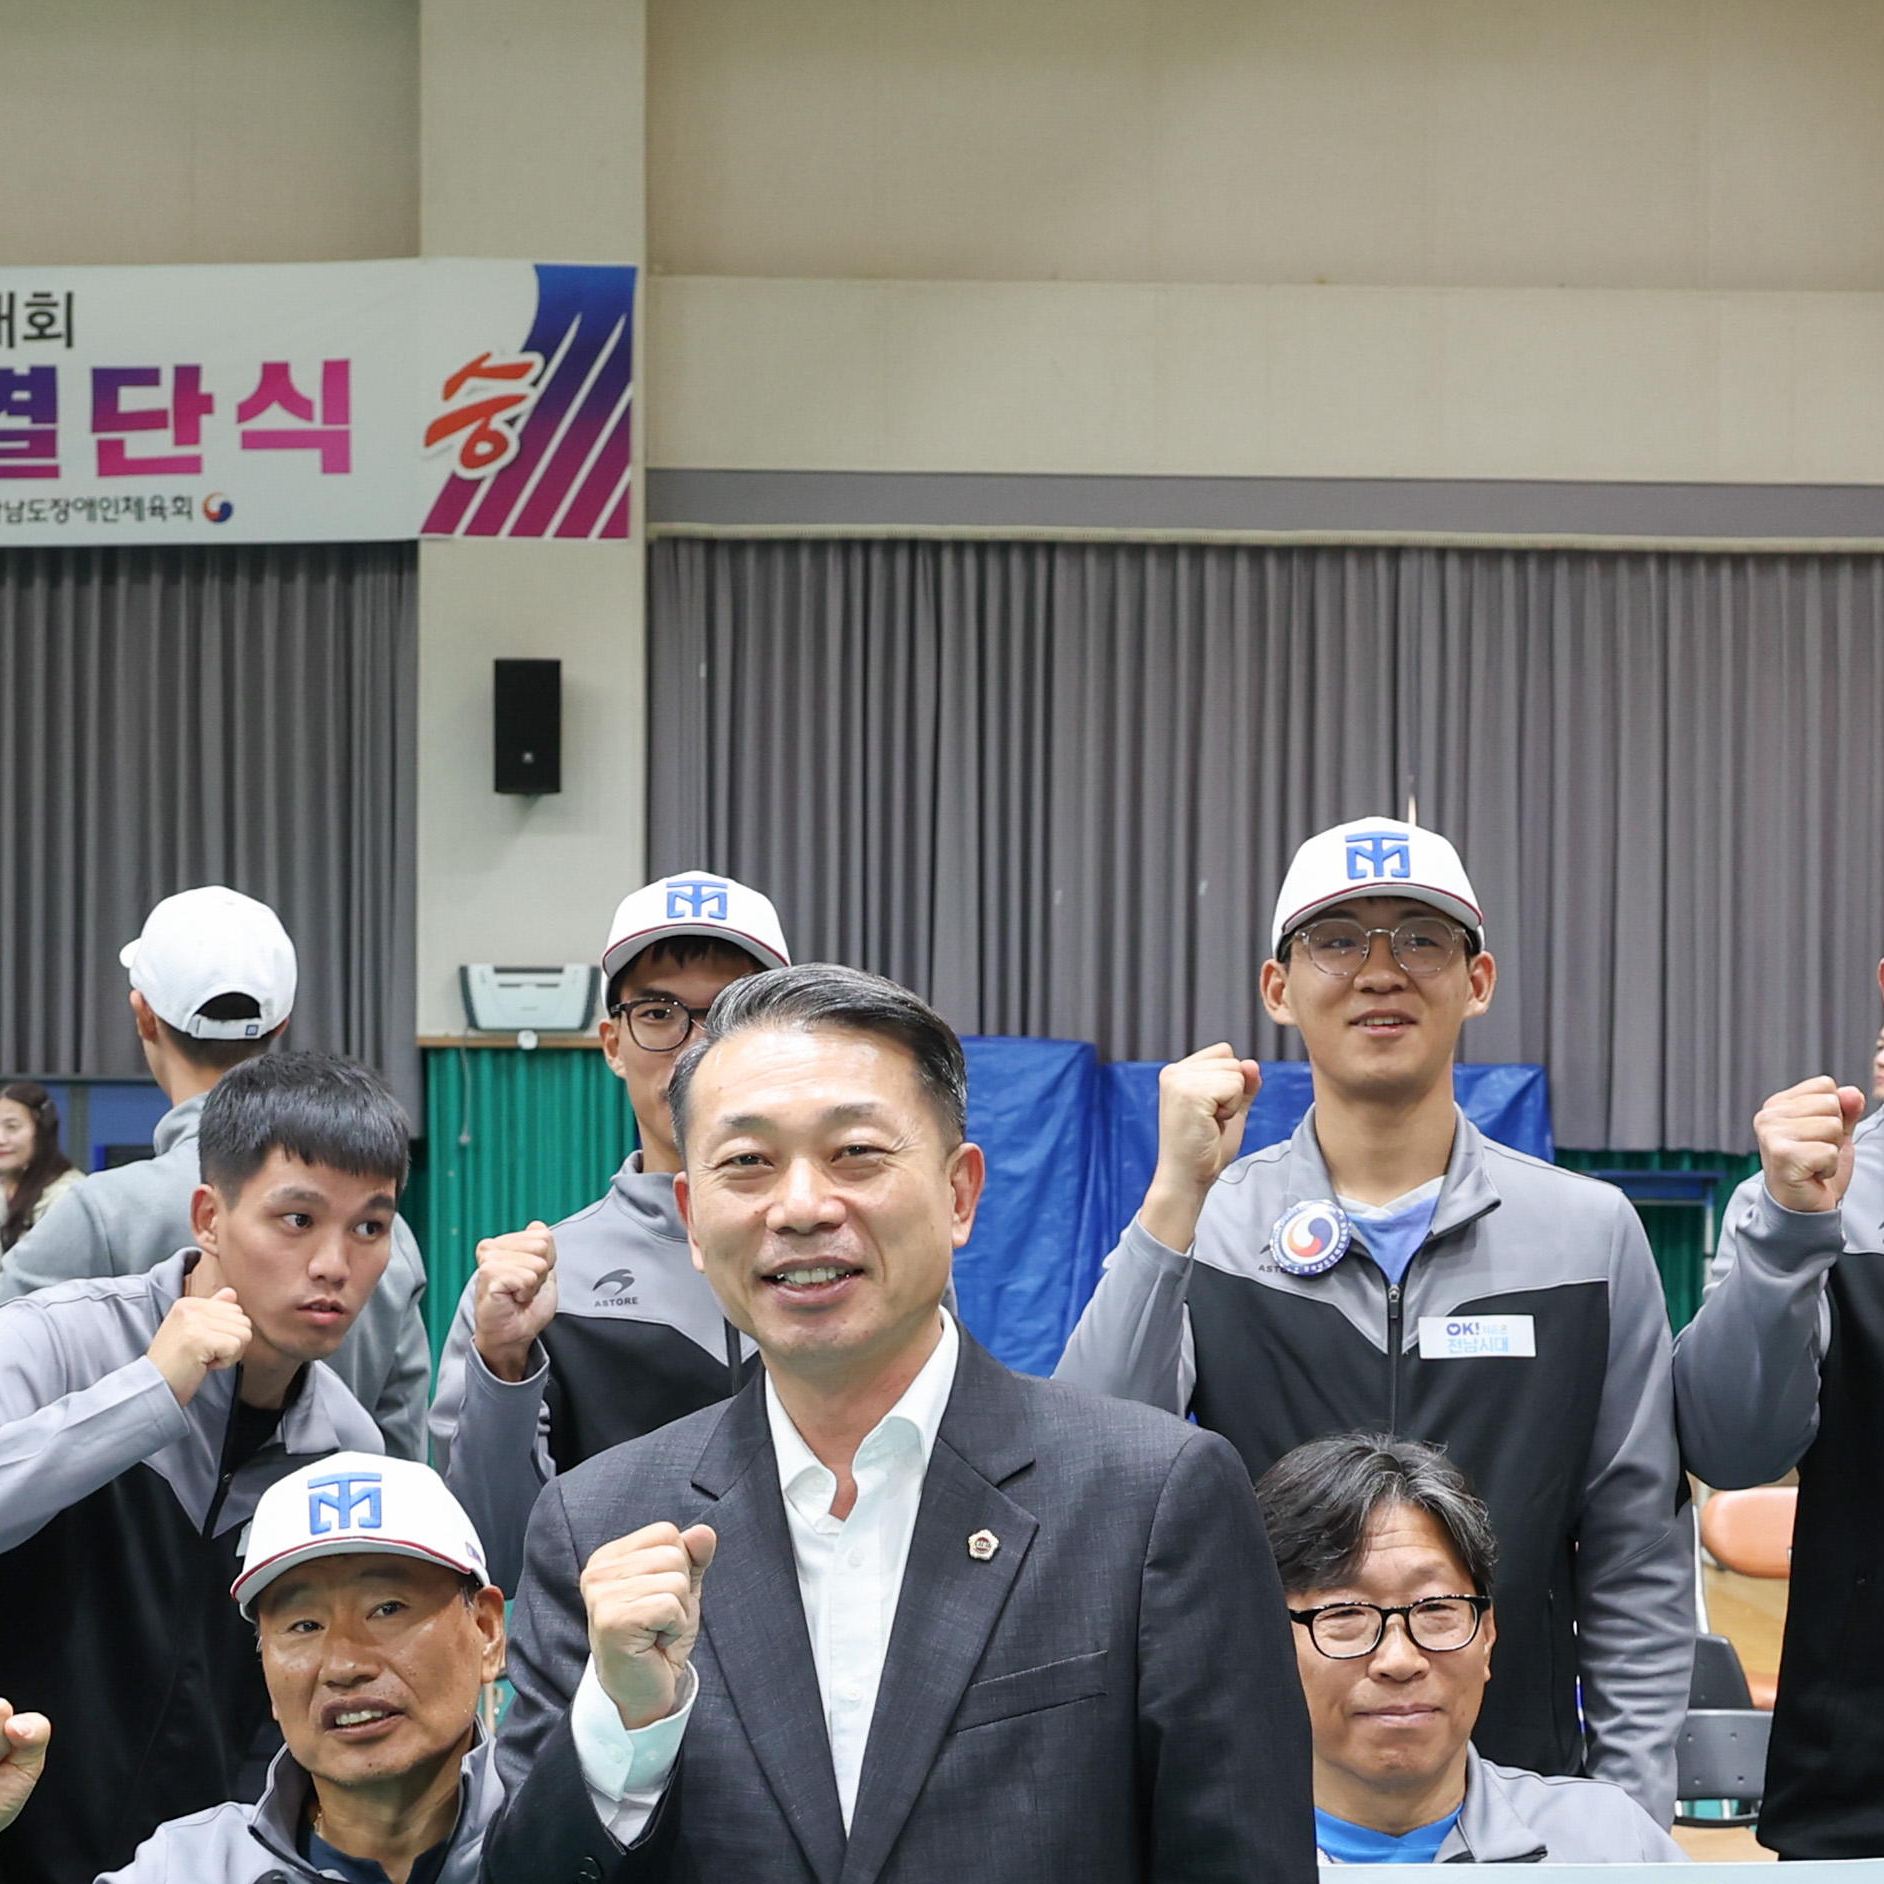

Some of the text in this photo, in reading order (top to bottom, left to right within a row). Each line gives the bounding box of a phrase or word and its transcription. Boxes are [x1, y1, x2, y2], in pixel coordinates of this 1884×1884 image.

[424, 351, 535, 470] 승
[594, 1296, 640, 1308] ASTORE
[1447, 1321, 1480, 1336] OK!
[1447, 1336, 1509, 1353] 전남시대
